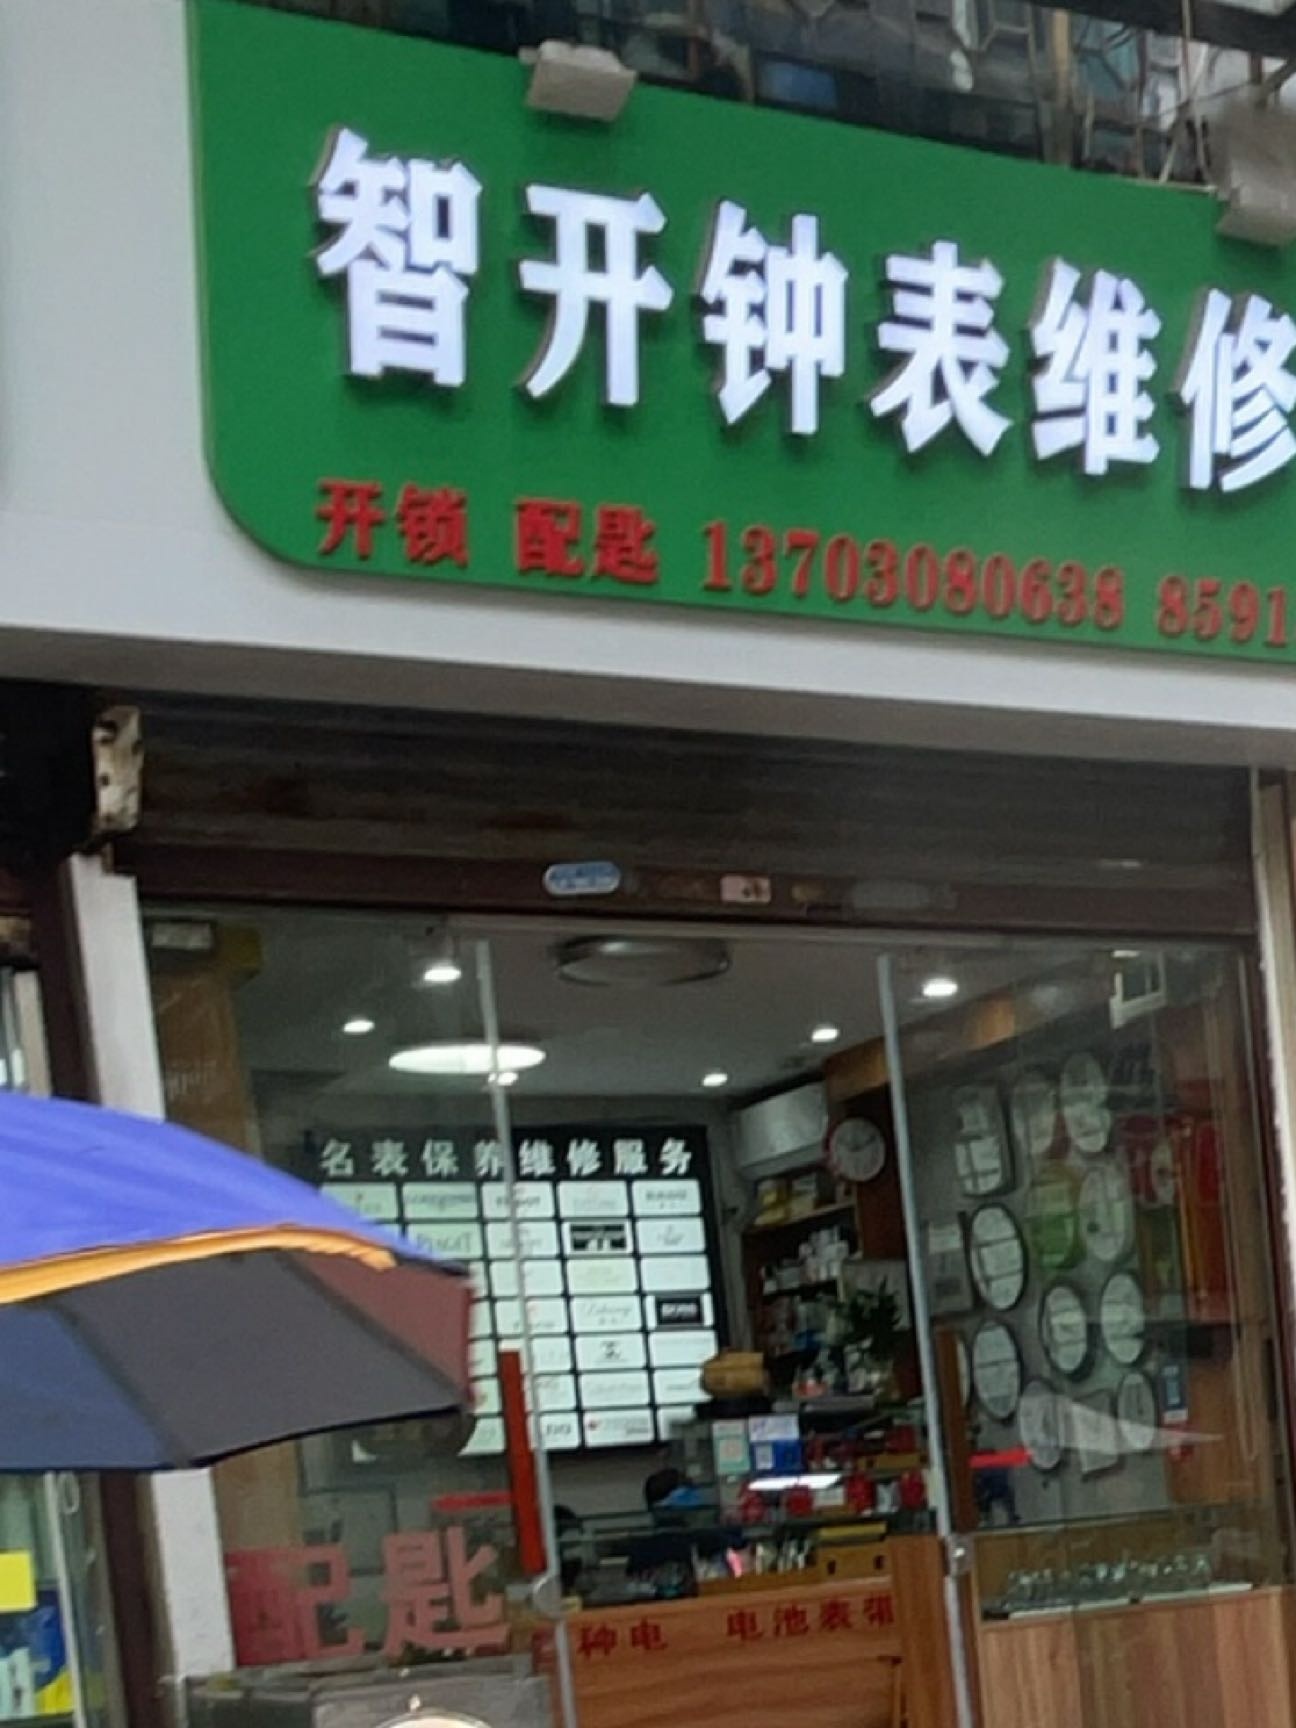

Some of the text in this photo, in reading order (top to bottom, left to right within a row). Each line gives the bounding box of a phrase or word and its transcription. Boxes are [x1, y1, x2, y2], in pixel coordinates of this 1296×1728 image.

[316, 478, 470, 566] 开锁
[514, 496, 659, 585] 配匙
[703, 522, 1124, 630] 13703080638
[321, 1138, 693, 1177] 名表保养维修服务
